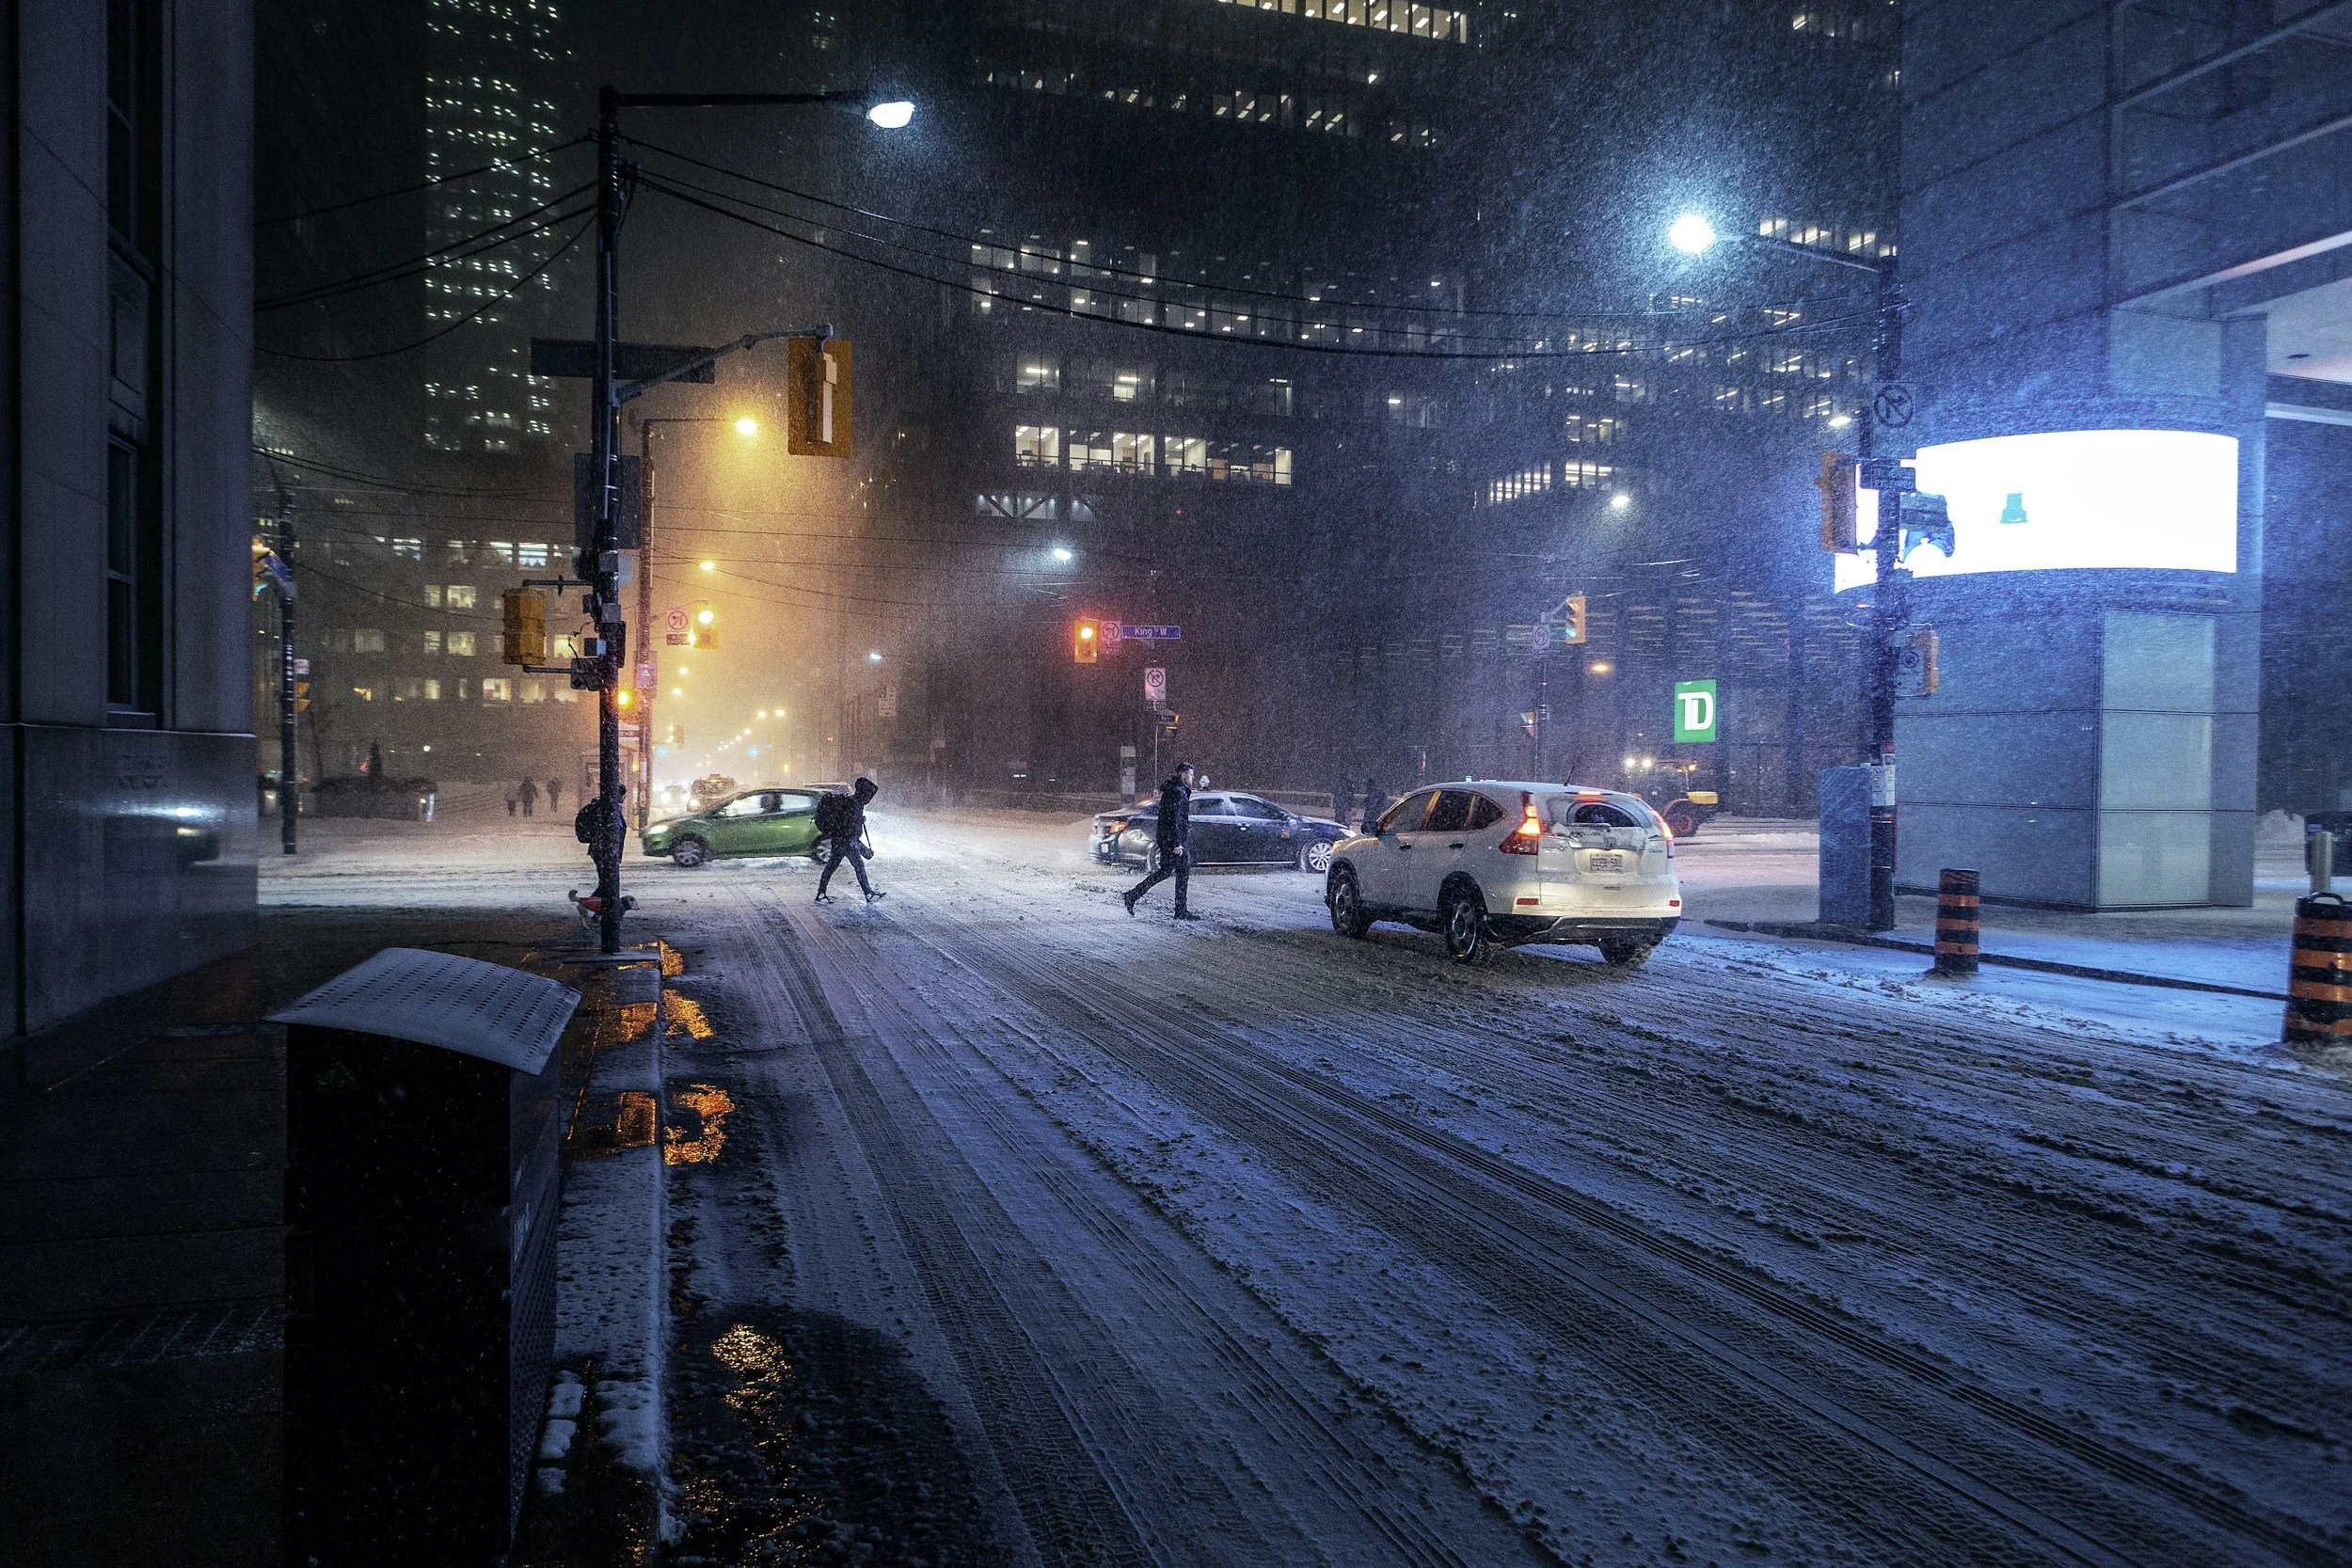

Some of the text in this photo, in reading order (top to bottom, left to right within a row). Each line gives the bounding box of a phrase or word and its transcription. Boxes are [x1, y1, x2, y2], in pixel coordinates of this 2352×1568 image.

[1135, 627, 1152, 638] King
[1160, 627, 1168, 636] W
[1677, 691, 1713, 731] TD
